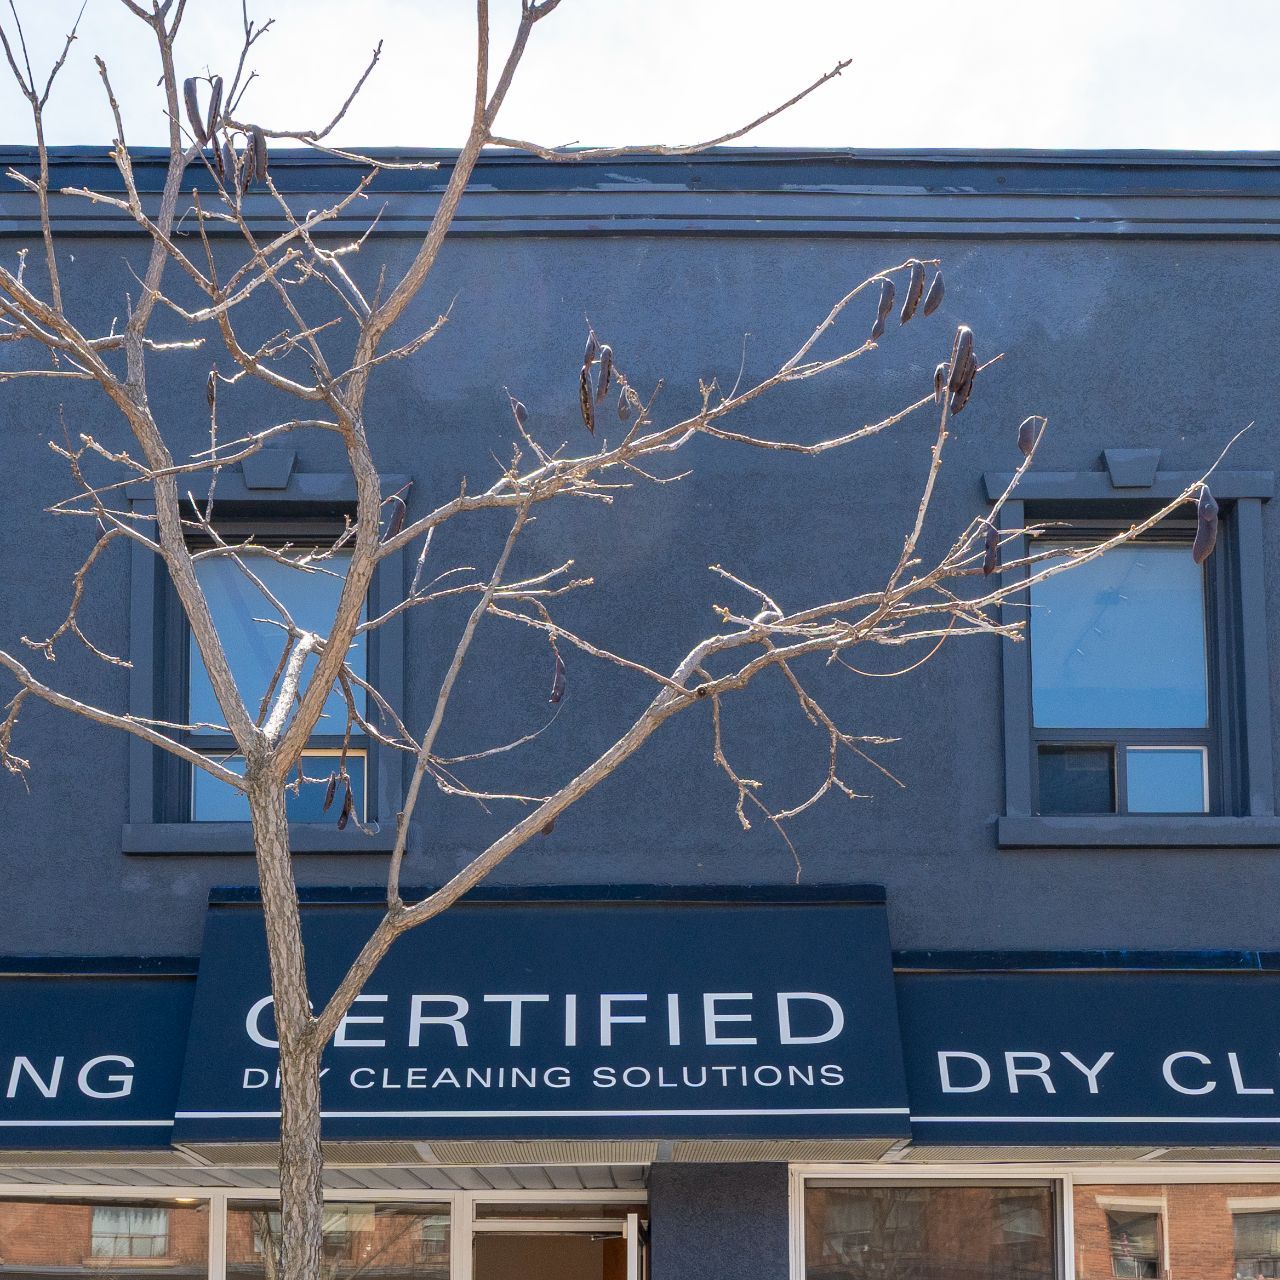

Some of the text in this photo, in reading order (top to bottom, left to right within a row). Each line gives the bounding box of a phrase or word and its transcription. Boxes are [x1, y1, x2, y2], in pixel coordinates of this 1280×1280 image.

[245, 993, 846, 1048] CERTIFIED
[349, 1067, 572, 1090] CLEANING
[592, 1064, 846, 1088] SOLUTIONS
[937, 1050, 1115, 1094] DRY
